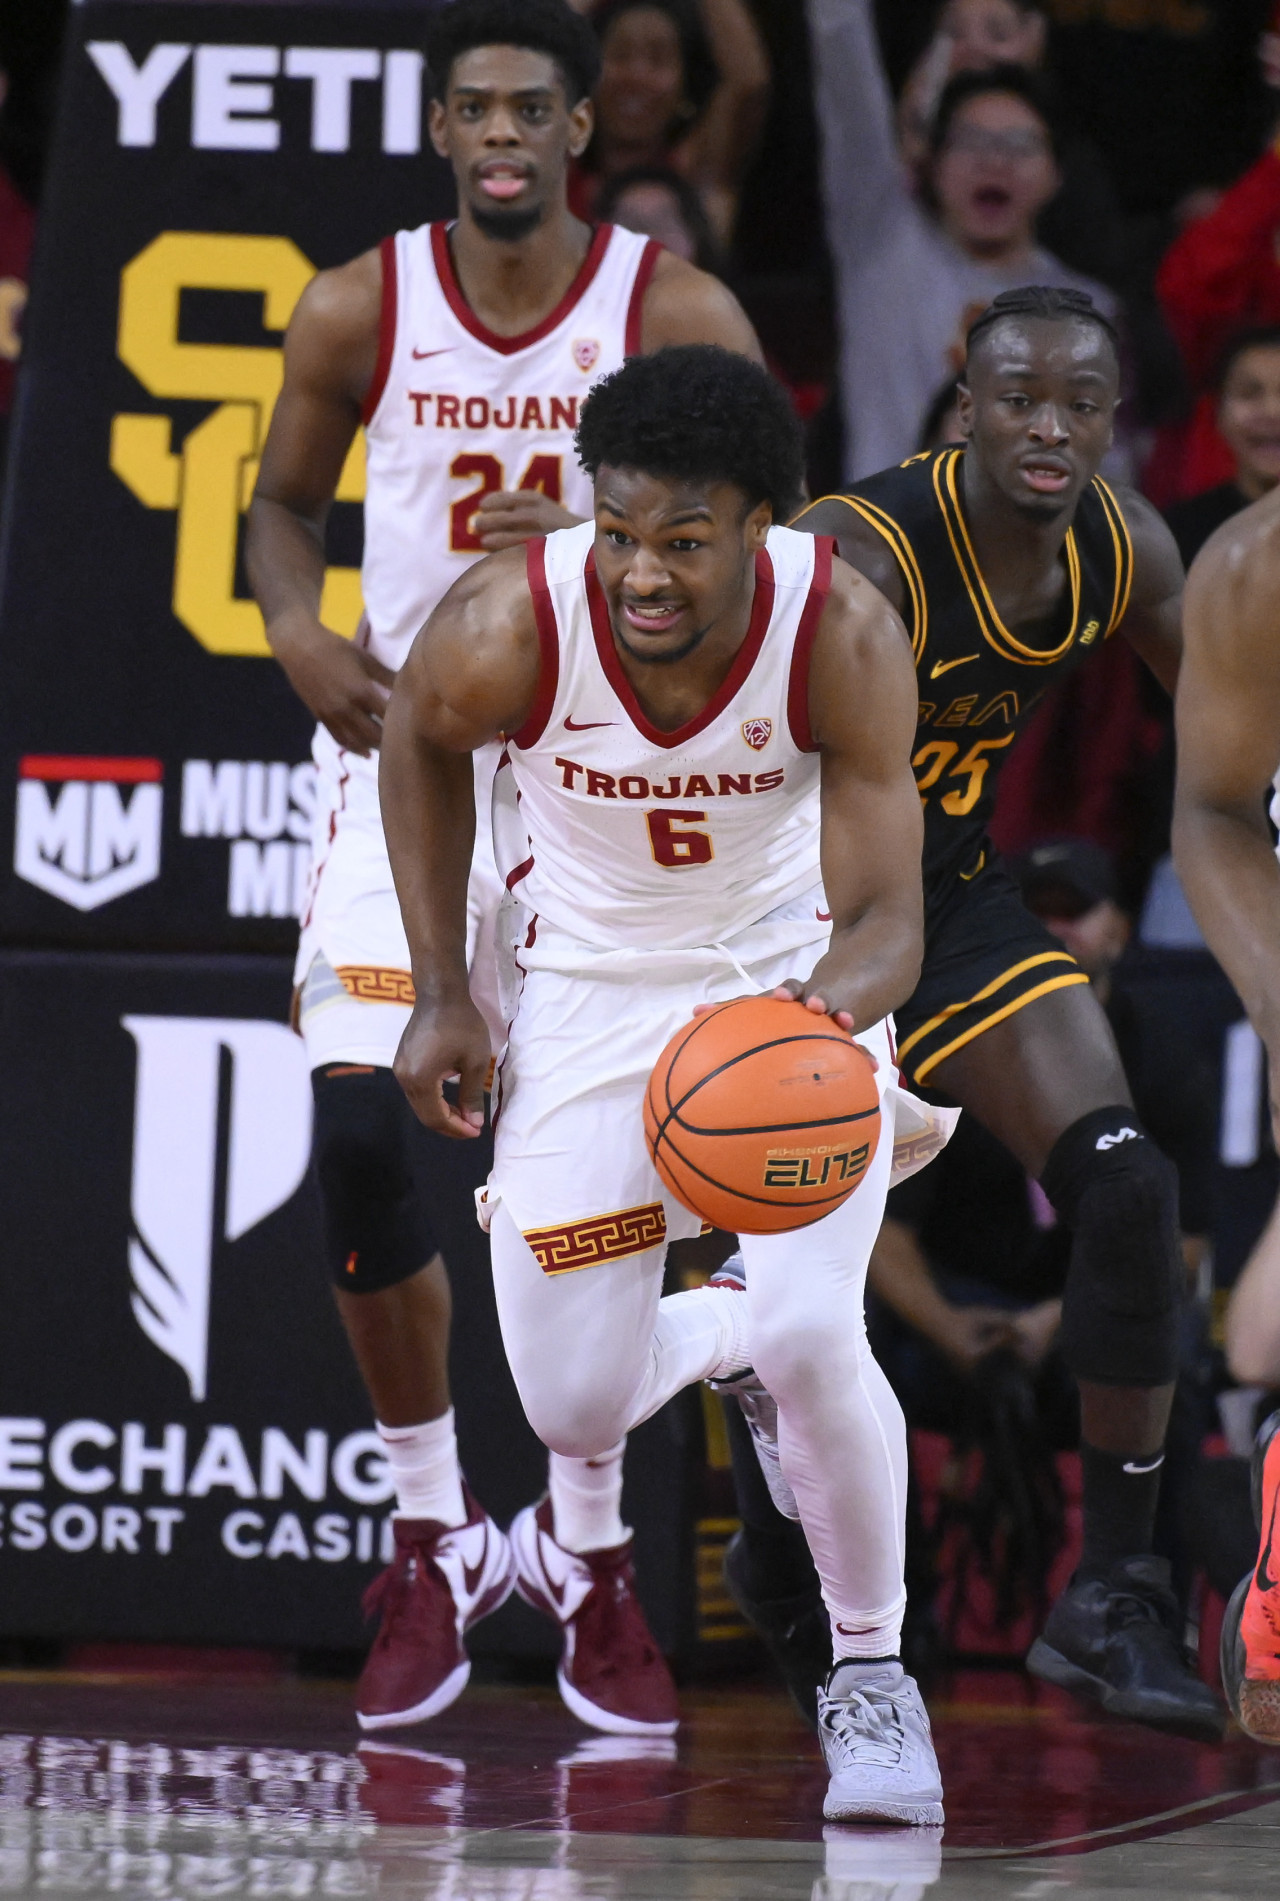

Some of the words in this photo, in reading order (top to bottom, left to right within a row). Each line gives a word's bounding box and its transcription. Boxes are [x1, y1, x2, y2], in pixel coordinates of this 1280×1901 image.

[85, 40, 423, 155] YETI
[408, 391, 588, 430] TROJAN
[750, 733, 765, 746] 12
[180, 759, 316, 839] MUS
[555, 756, 785, 800] TROJANS
[911, 731, 1016, 816] 25
[643, 808, 715, 868] 6
[763, 1142, 870, 1188] ELITE
[0, 1416, 396, 1505] ECHANG
[0, 1502, 184, 1555] SORT
